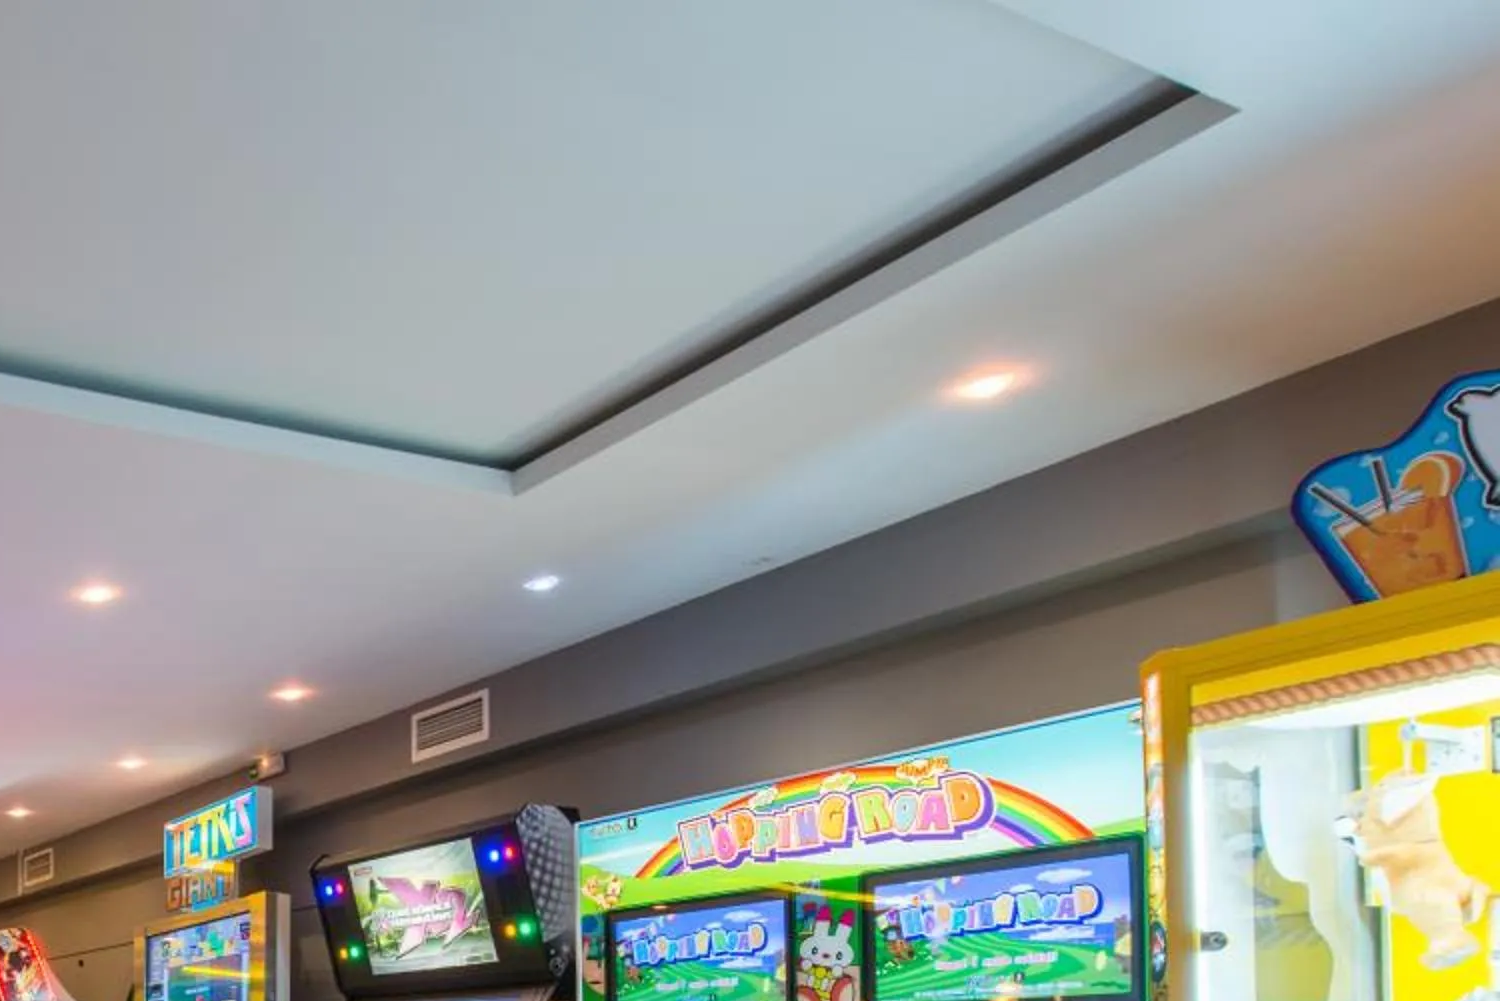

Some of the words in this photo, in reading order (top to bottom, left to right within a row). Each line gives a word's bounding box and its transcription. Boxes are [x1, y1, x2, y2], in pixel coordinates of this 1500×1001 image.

[165, 792, 253, 869] TETRIS
[680, 792, 850, 866] HOPPING
[854, 772, 990, 842] ROAD
